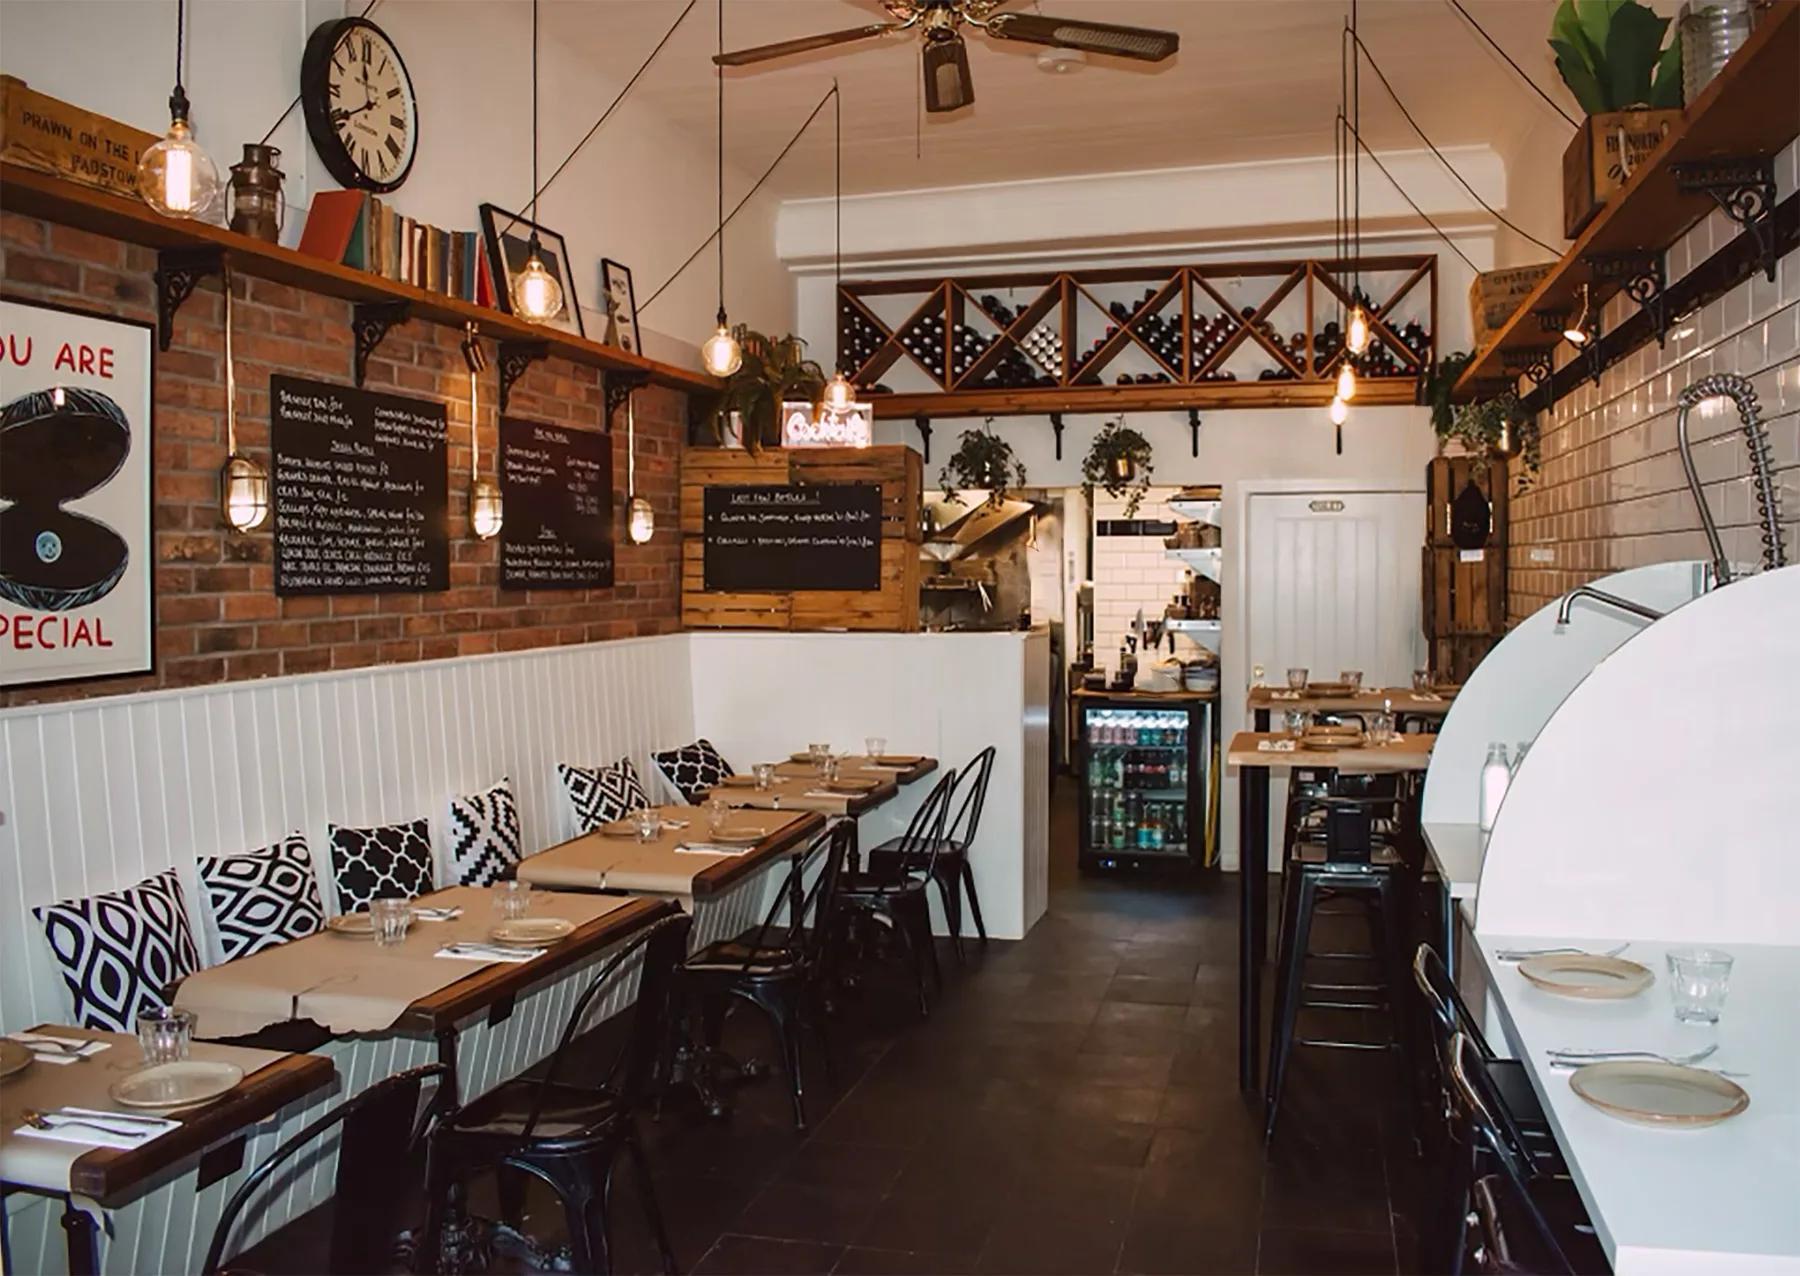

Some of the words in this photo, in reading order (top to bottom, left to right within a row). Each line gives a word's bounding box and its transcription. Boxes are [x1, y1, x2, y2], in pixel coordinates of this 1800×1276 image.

[22, 110, 72, 142] PRAWN
[79, 131, 98, 150] ON
[104, 138, 130, 162] THE
[70, 154, 137, 186] PADSTOW
[54, 342, 115, 379] ARE
